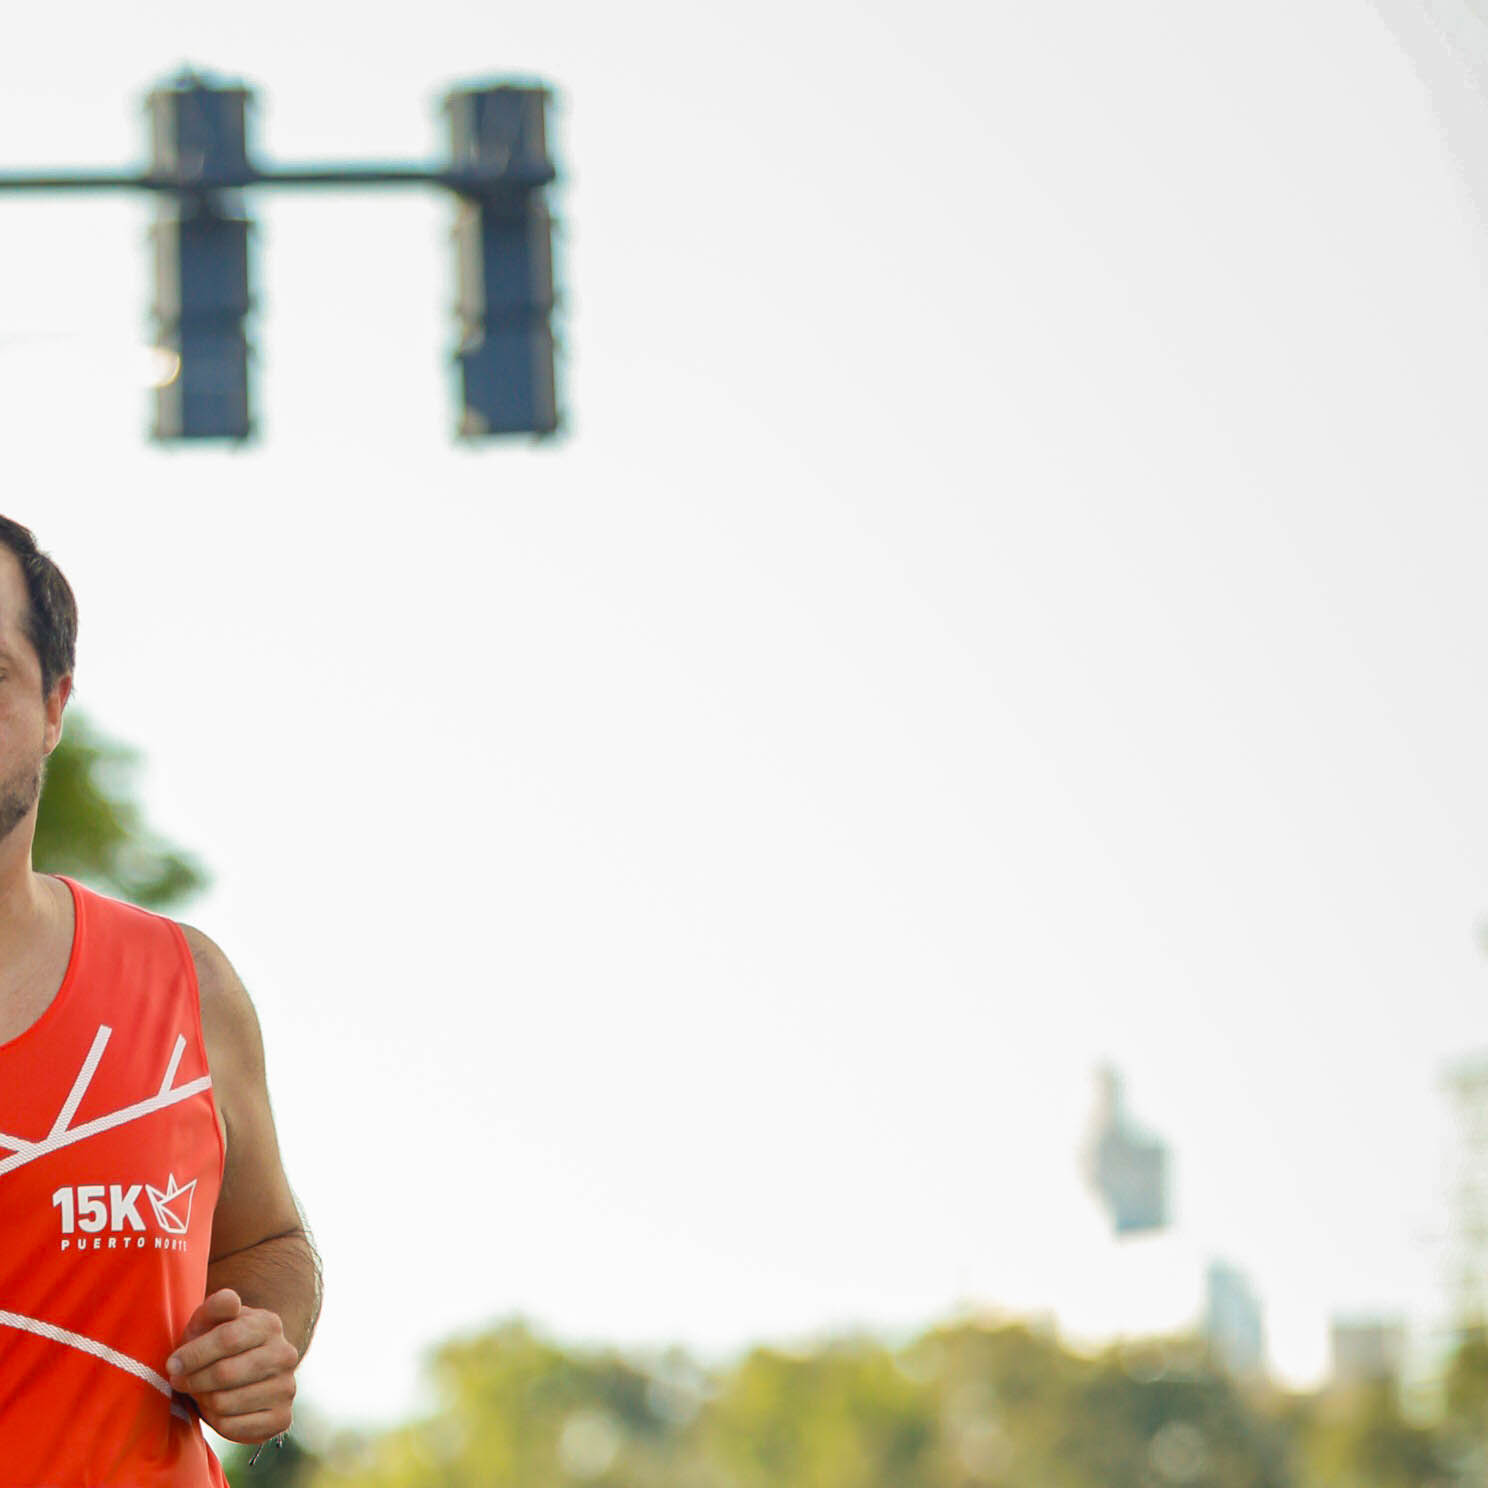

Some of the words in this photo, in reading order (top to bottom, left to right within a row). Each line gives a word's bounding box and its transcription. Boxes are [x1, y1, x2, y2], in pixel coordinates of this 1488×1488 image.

[52, 1184, 147, 1234] 15K
[61, 1237, 145, 1251] PUERTO
[154, 1237, 187, 1252] NORTE
